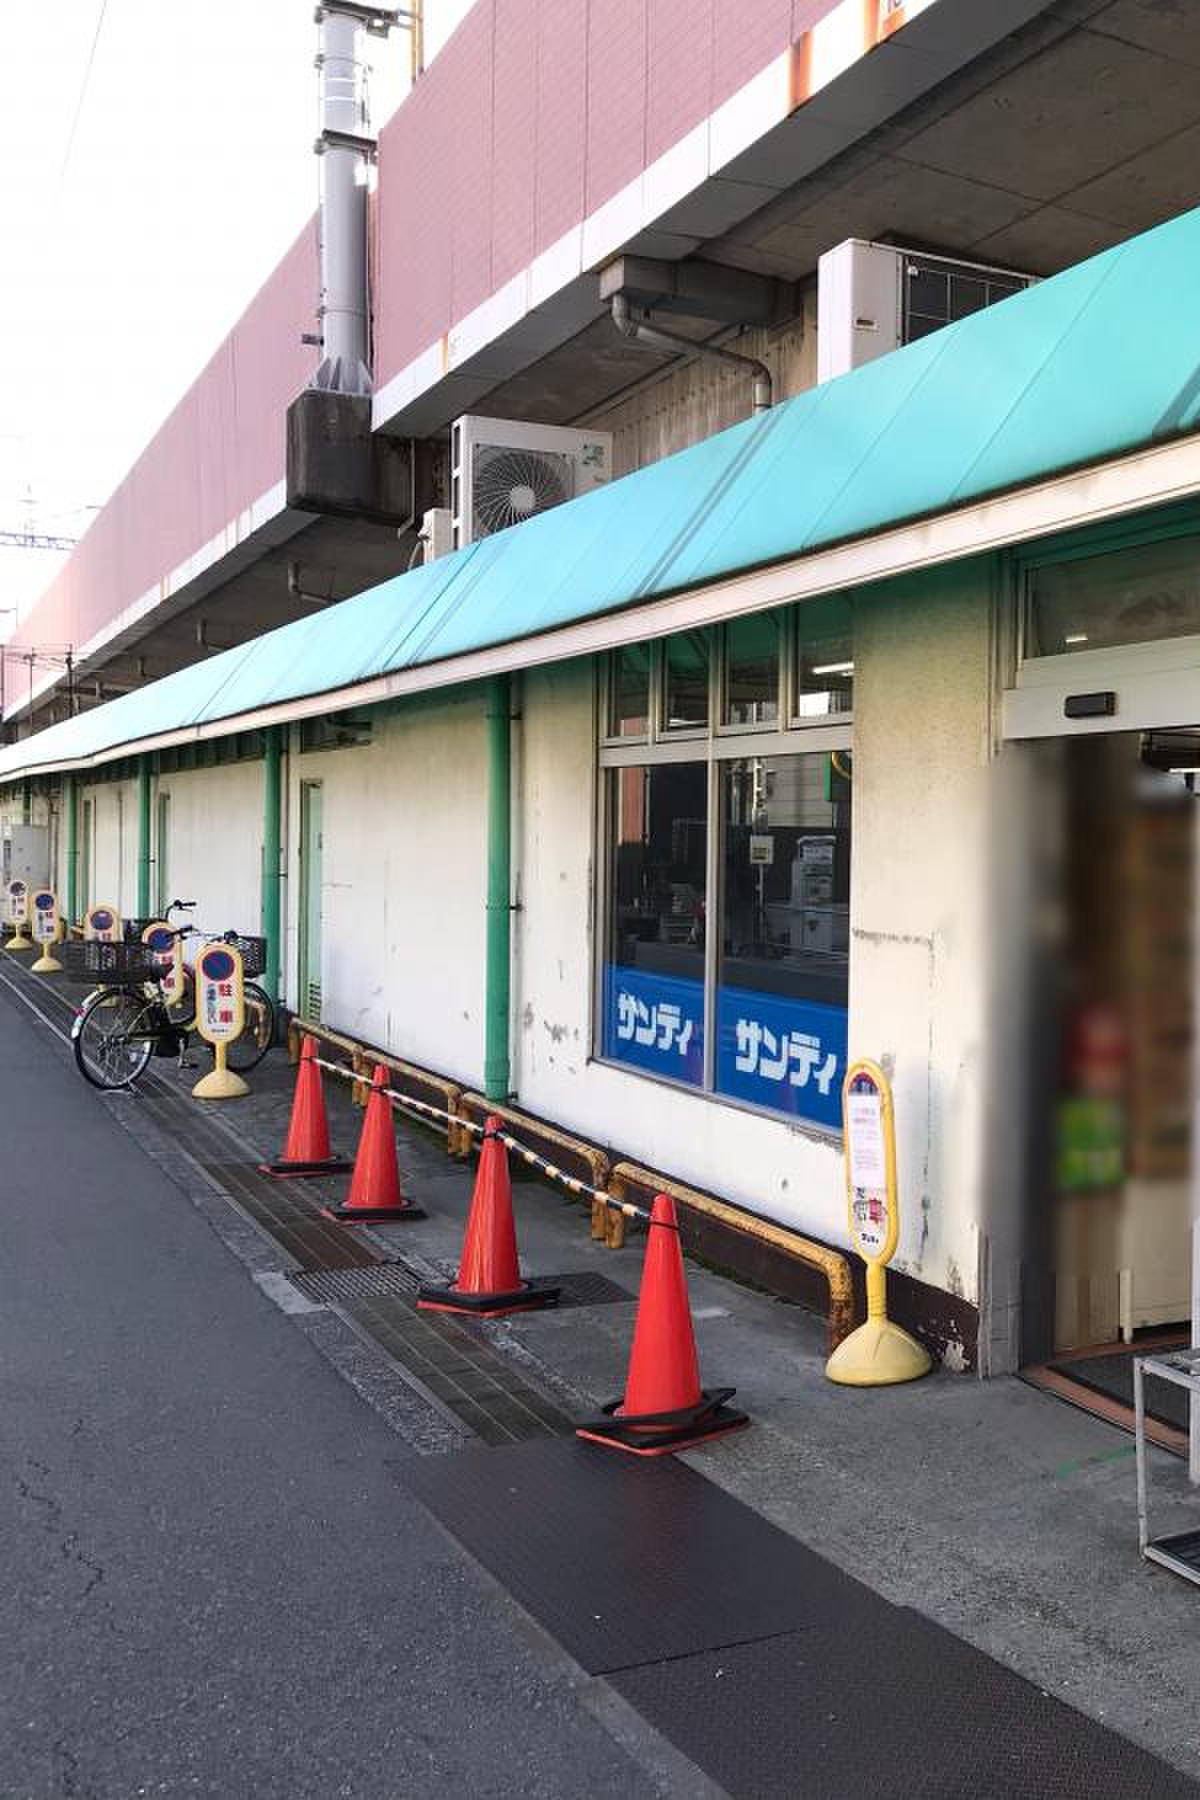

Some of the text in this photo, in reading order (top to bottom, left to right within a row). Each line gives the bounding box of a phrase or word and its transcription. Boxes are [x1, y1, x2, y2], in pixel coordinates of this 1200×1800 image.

[617, 991, 693, 1056] サンディ
[736, 1018, 838, 1096] サンディ
